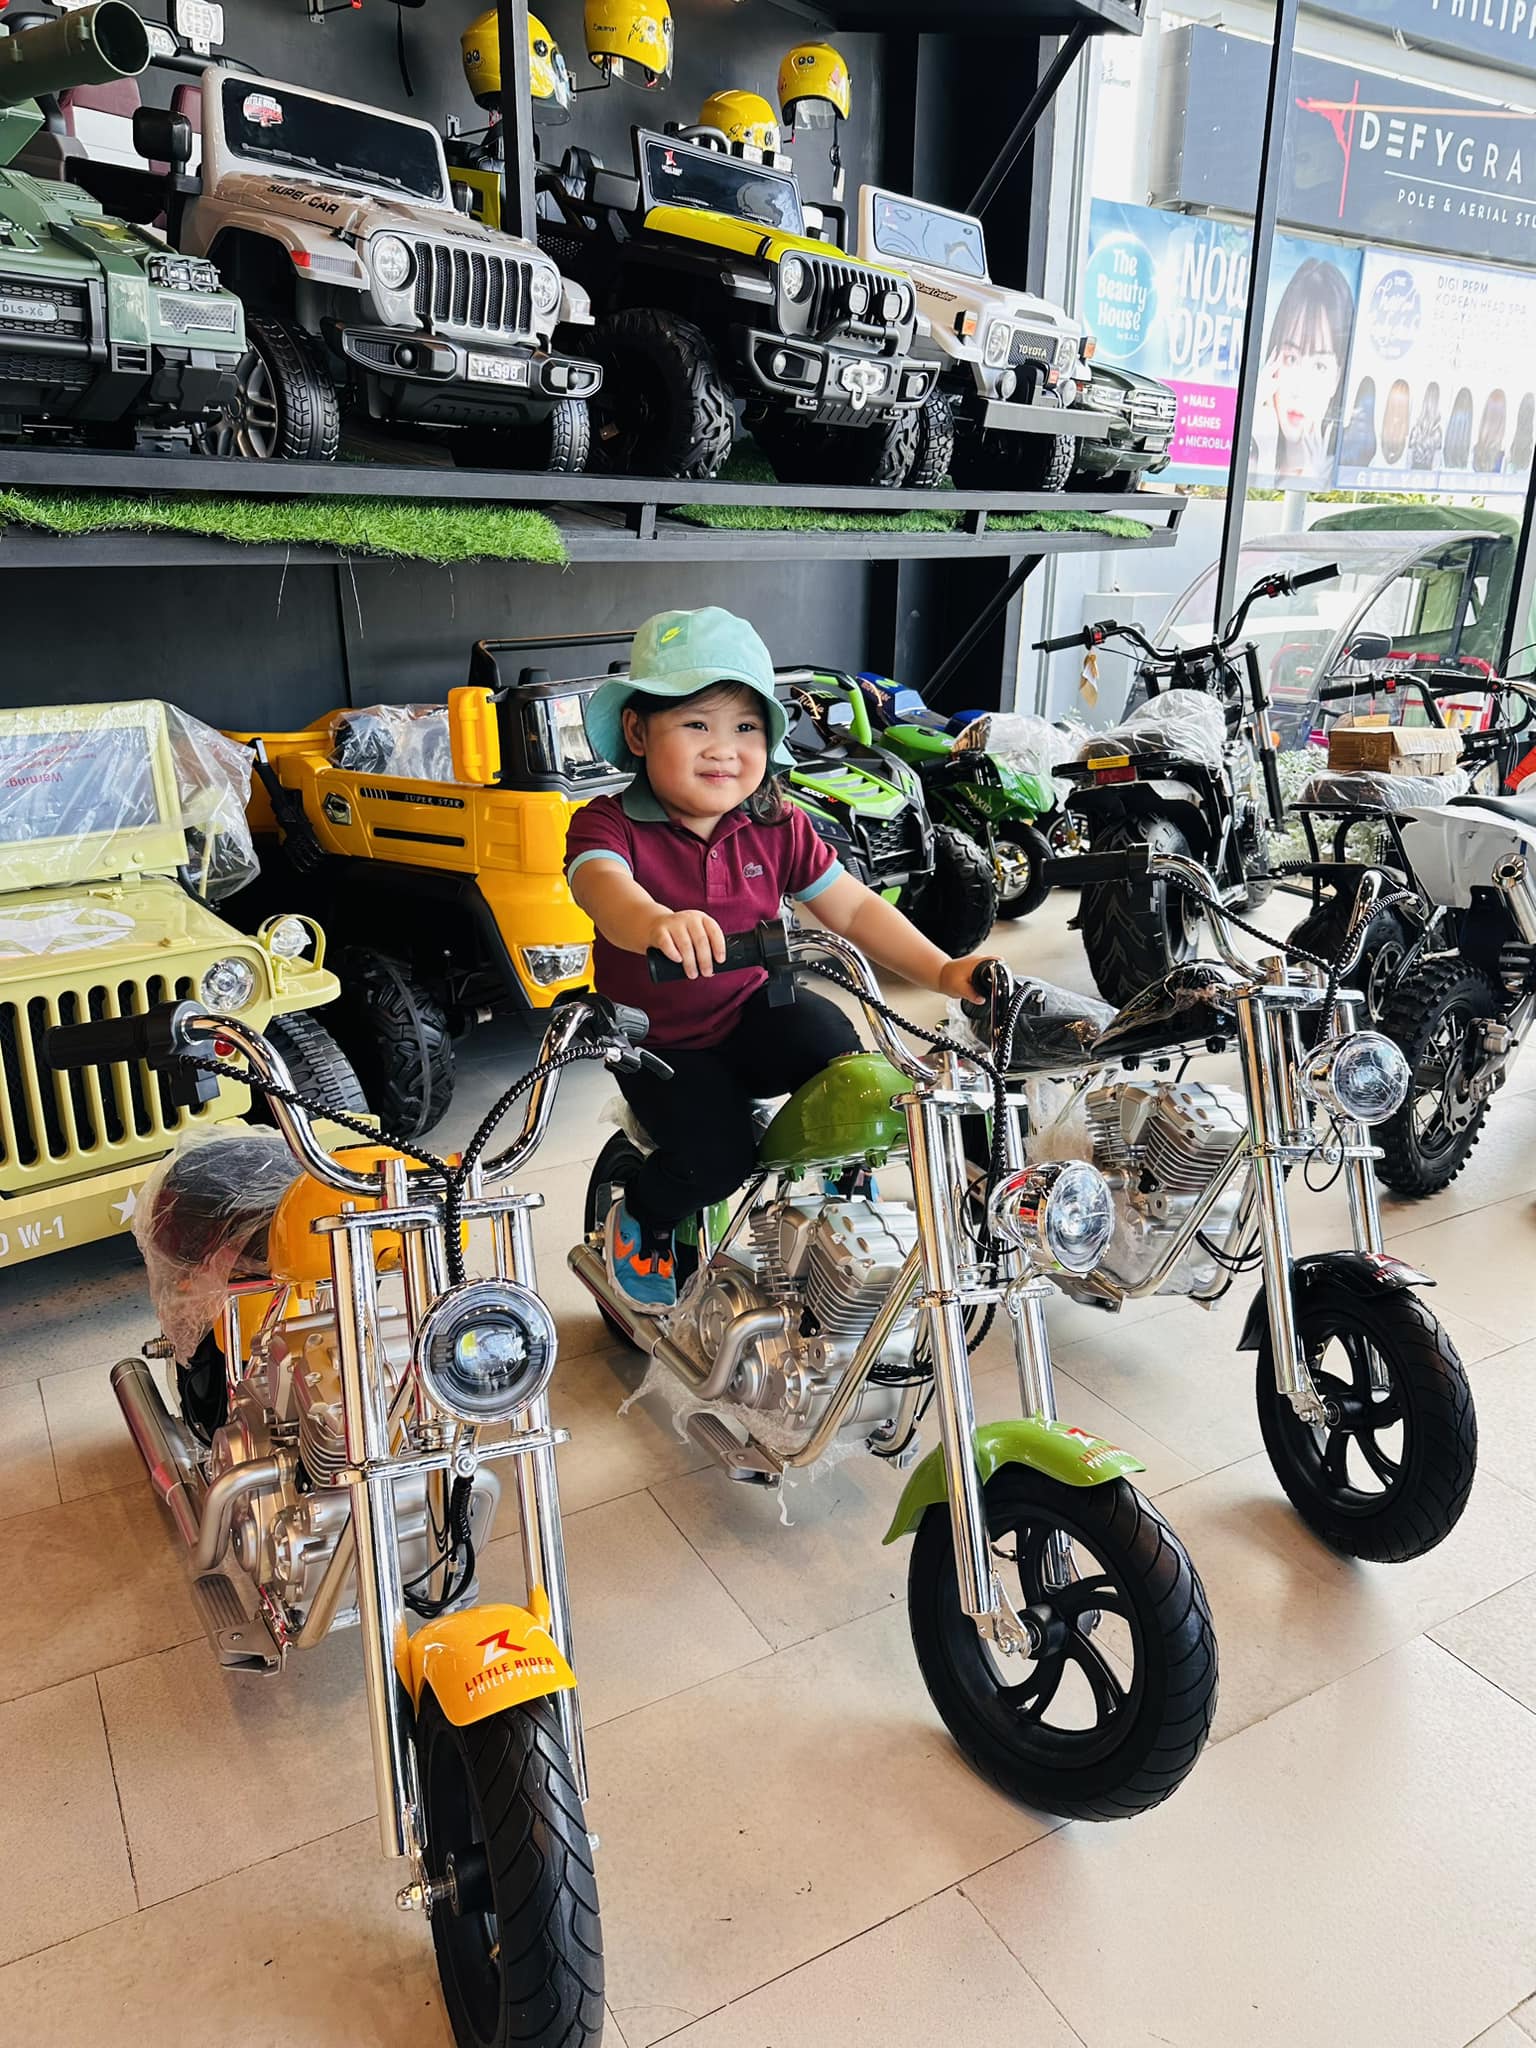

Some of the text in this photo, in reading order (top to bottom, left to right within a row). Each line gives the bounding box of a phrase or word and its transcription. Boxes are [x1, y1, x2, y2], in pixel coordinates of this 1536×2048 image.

[1360, 111, 1522, 184] DEFYGRA
[308, 196, 340, 215] CAR
[1398, 189, 1435, 209] POLE
[1443, 198, 1452, 212] &
[1459, 201, 1508, 224] AERIAL
[1113, 249, 1137, 276] The
[1096, 273, 1148, 312] Beauty
[1438, 275, 1459, 290] DIGI
[1097, 301, 1142, 331] House
[1018, 344, 1047, 359] TOYOTA
[1188, 394, 1216, 409] NAILS
[1187, 415, 1222, 430] LASHES
[17, 1215, 65, 1249] W-1
[464, 1656, 555, 1693] LITTLE RIDER
[467, 1664, 557, 1702] PHILIPPINES
